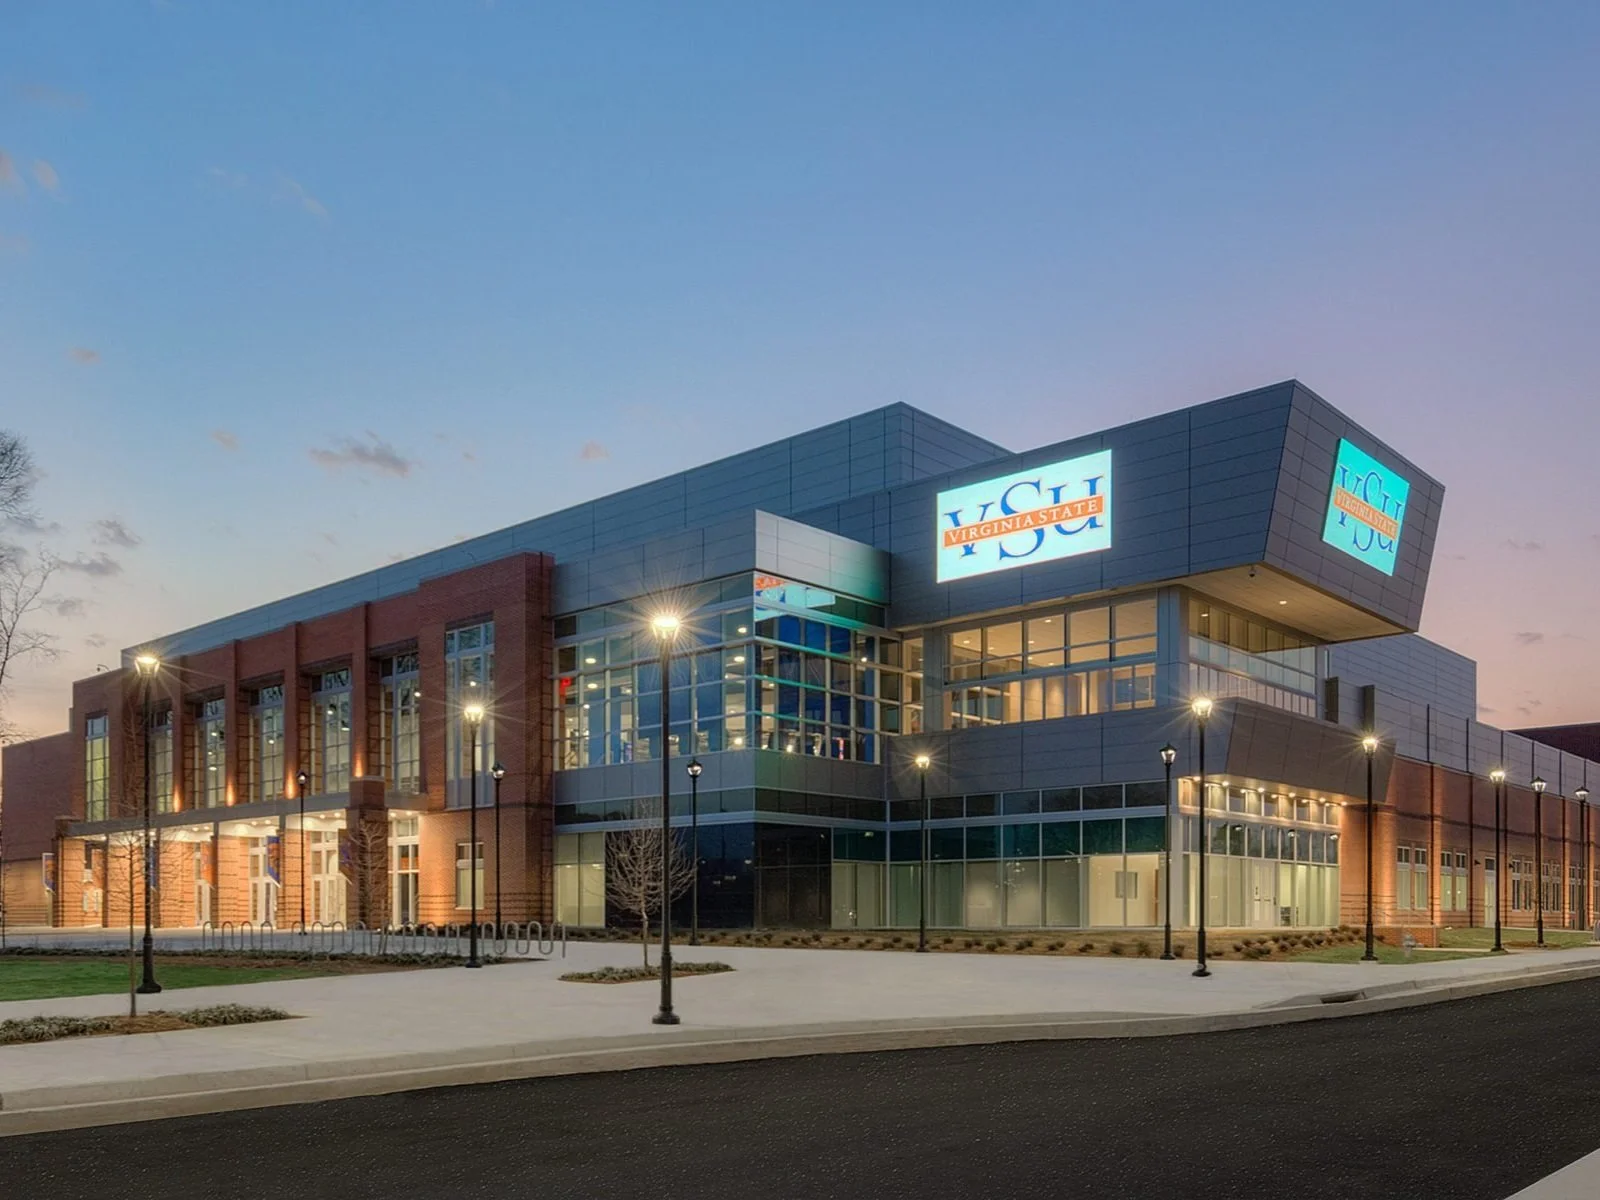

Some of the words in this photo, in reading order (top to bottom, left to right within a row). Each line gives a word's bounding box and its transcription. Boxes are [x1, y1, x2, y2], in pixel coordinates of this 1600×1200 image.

[944, 475, 1103, 560] VSU
[949, 516, 1034, 544] VIRGINIA
[1039, 501, 1098, 525] STATE
[1336, 488, 1373, 523] VIRGINIA
[1372, 511, 1398, 539] STATE
